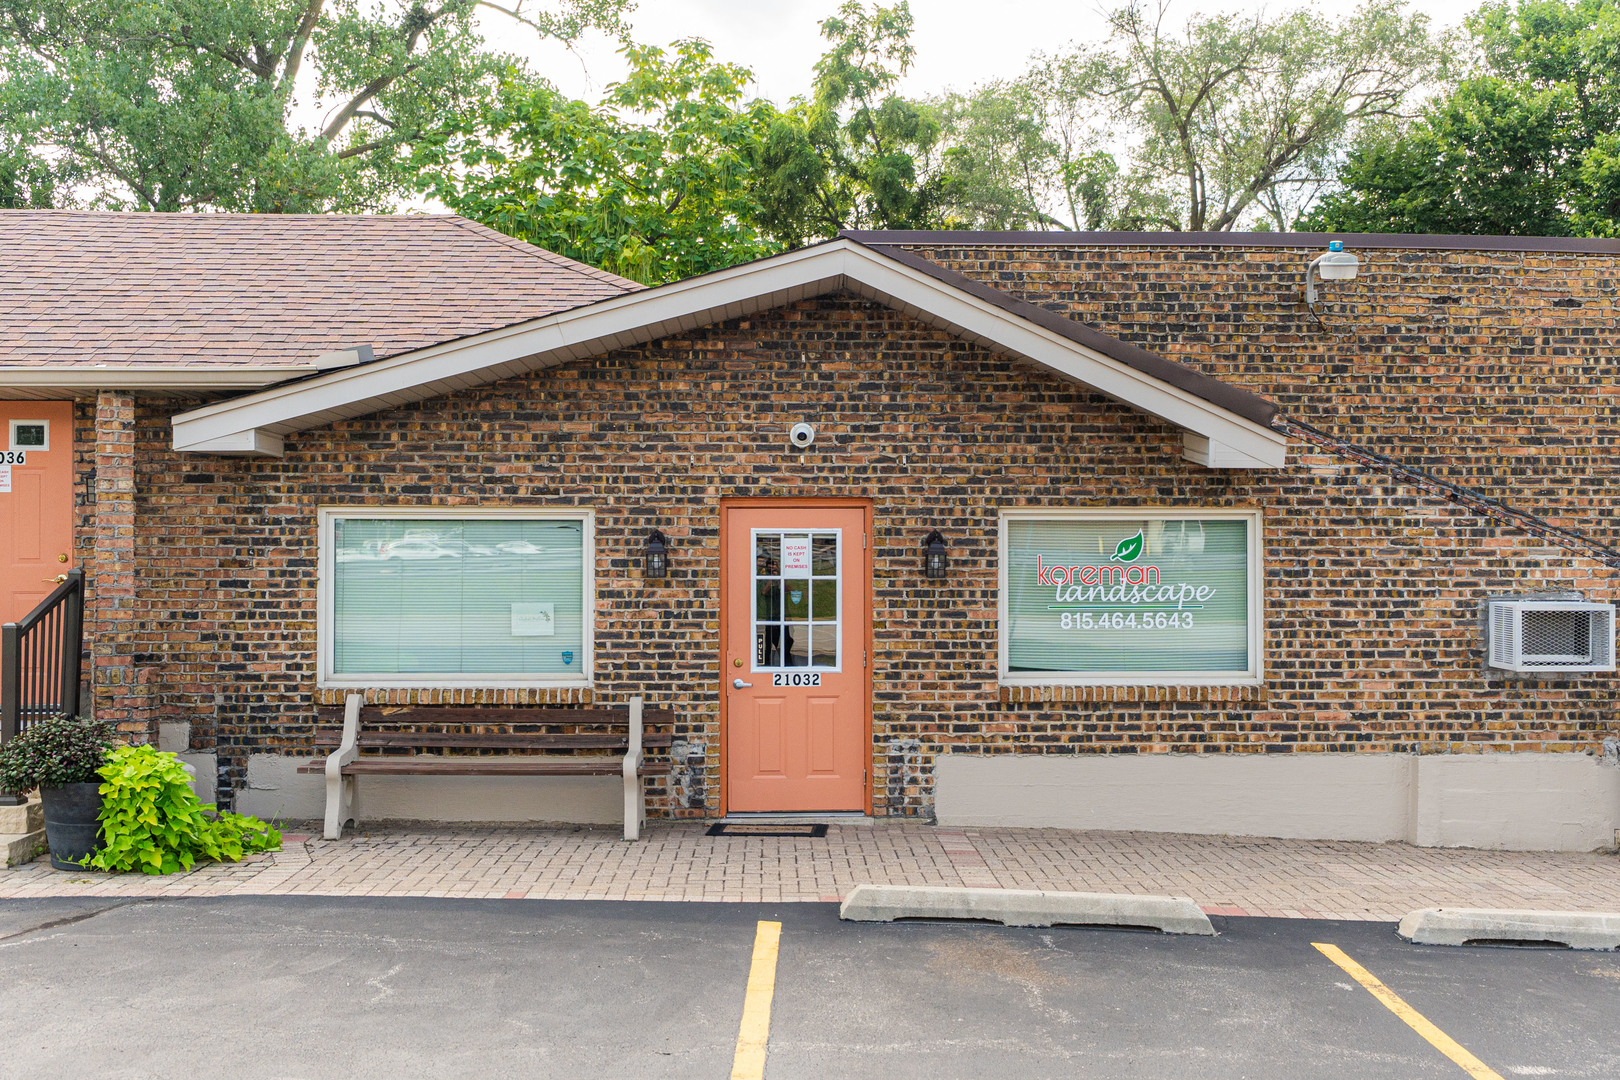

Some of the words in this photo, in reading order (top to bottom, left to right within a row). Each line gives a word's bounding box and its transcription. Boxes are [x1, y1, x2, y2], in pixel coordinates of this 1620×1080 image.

[1037, 554, 1160, 585] koreman
[1055, 577, 1216, 610] landscape
[1060, 612, 1194, 629] 815.464.5643
[774, 673, 820, 686] 21032
